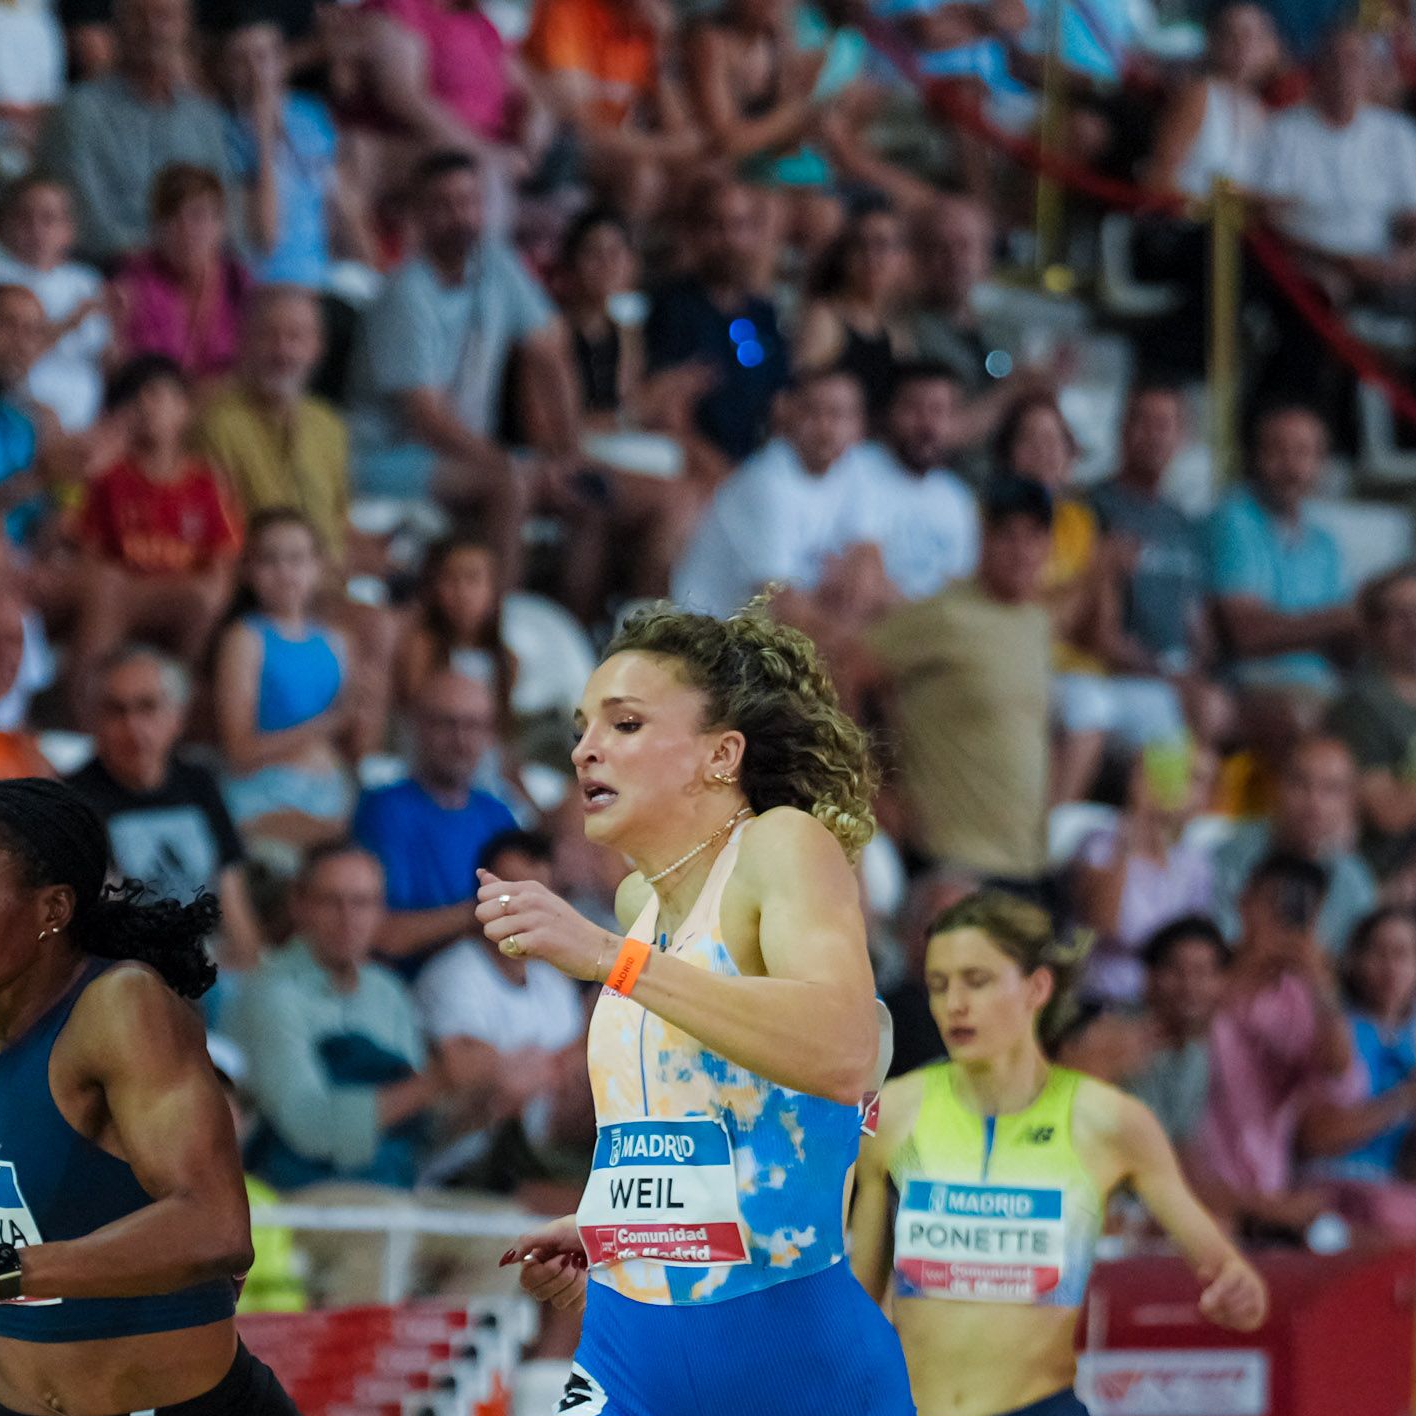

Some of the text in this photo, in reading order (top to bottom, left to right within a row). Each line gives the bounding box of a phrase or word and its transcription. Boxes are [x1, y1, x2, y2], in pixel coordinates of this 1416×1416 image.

[621, 1134, 695, 1162] MADRID
[610, 1178, 684, 1209] WEIL
[948, 1190, 1032, 1220] MADRID
[617, 1227, 708, 1244] Comunidad
[909, 1222, 1049, 1255] PONETTE
